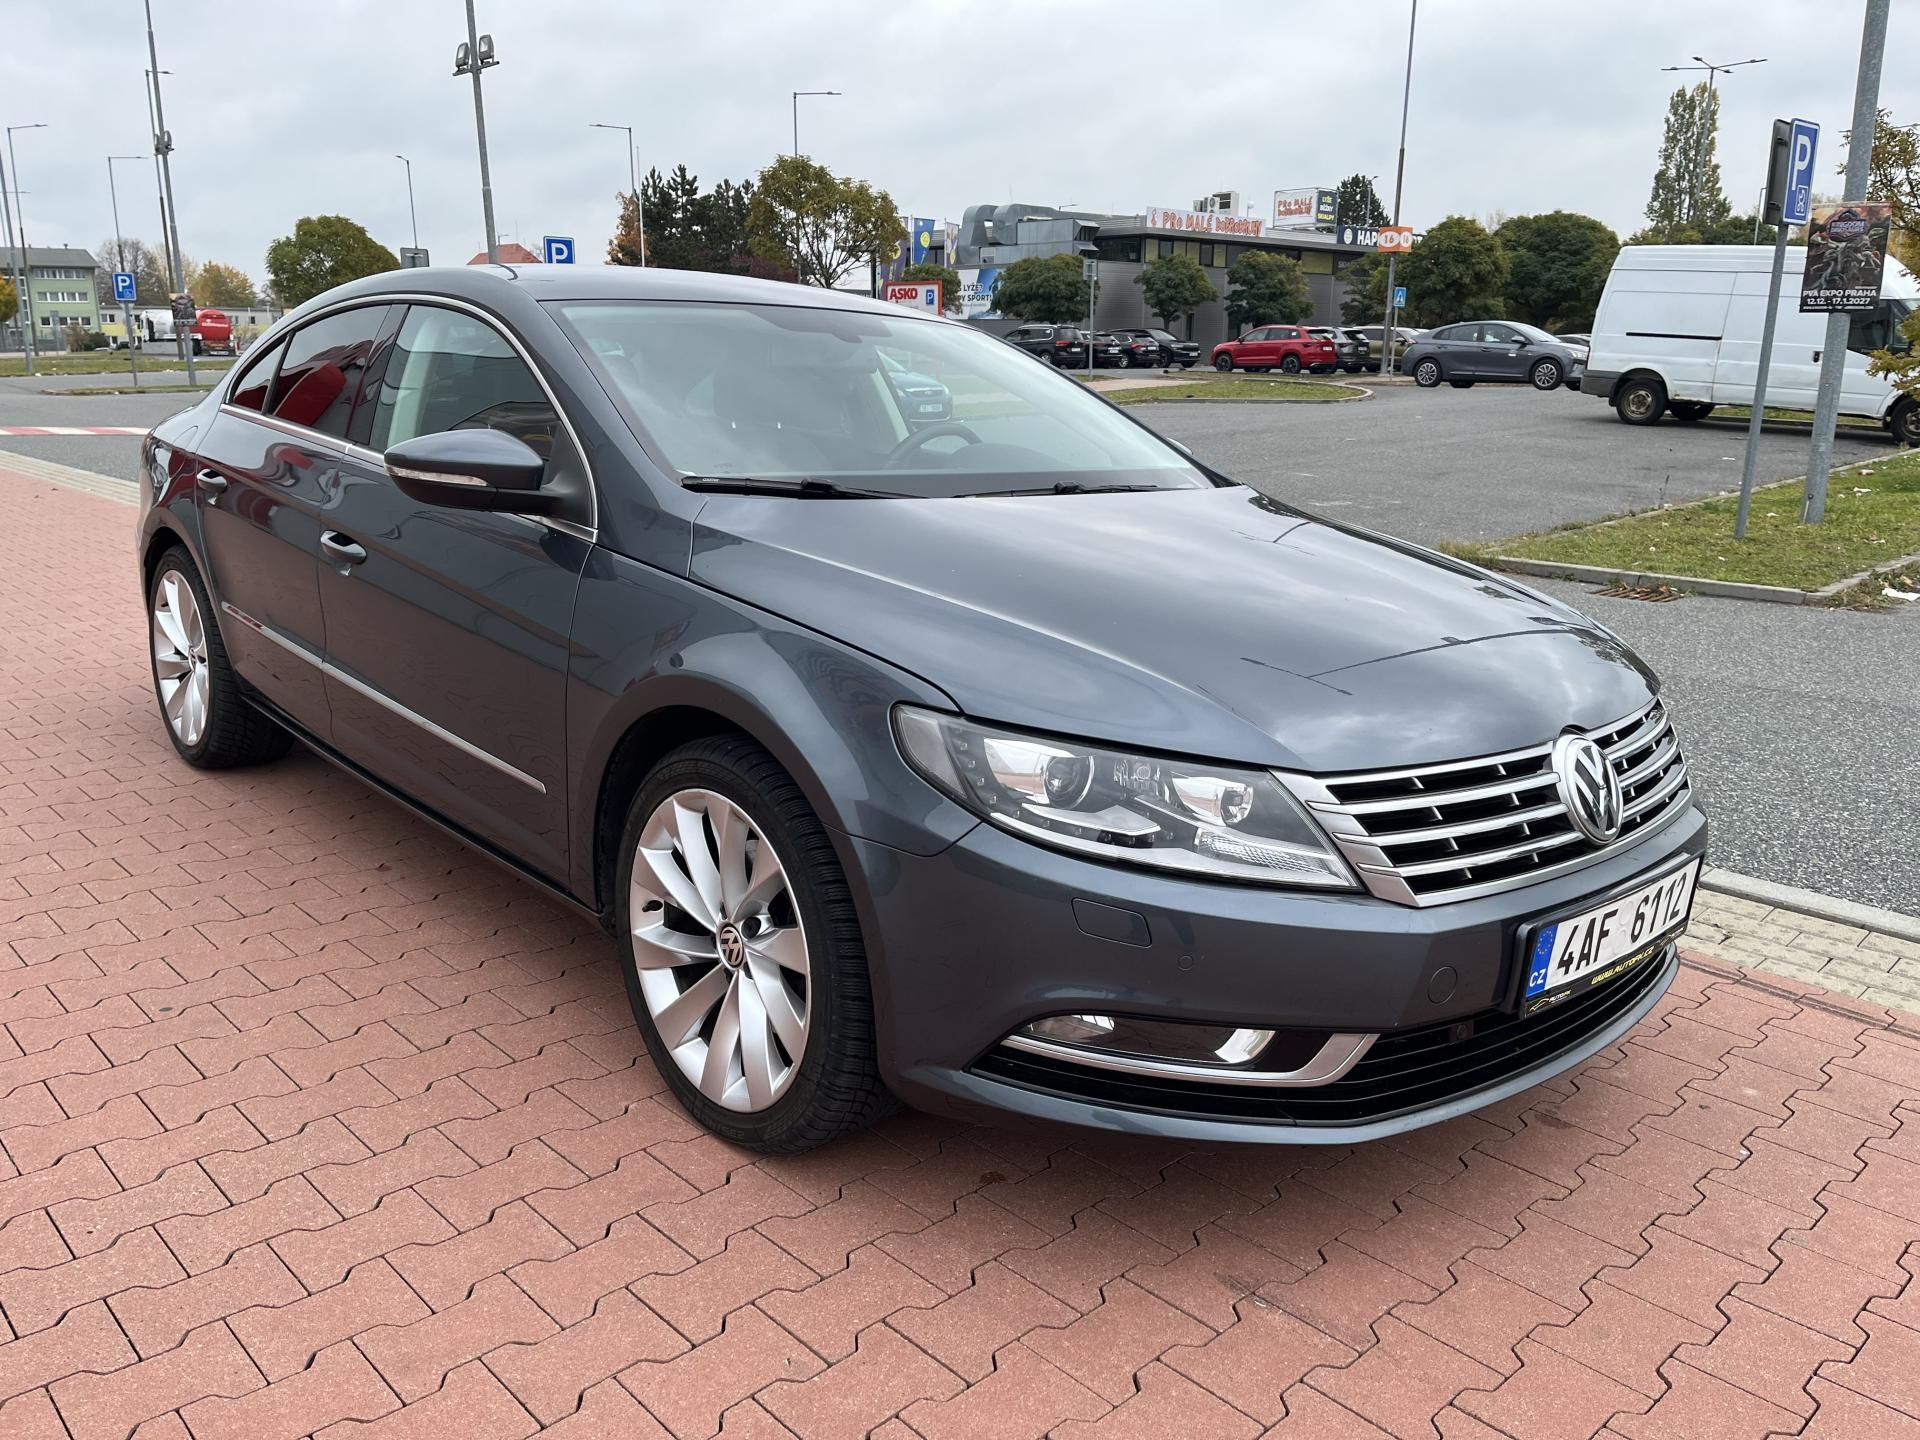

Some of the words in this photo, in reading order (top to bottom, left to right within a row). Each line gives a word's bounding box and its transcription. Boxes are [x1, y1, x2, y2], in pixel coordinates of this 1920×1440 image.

[1791, 134, 1811, 191] P
[1162, 211, 1183, 229] PRO
[1185, 214, 1213, 233] MALÉ
[1384, 234, 1395, 243] 16
[551, 242, 568, 264] P
[117, 275, 130, 292] P
[889, 287, 918, 300] ASKO
[927, 292, 934, 303] P
[967, 294, 992, 302] SPORT!
[1845, 289, 1877, 297] PRAHA
[1557, 909, 1620, 976] 4AF
[1630, 872, 1687, 943] 6112
[1529, 968, 1545, 988] CZ
